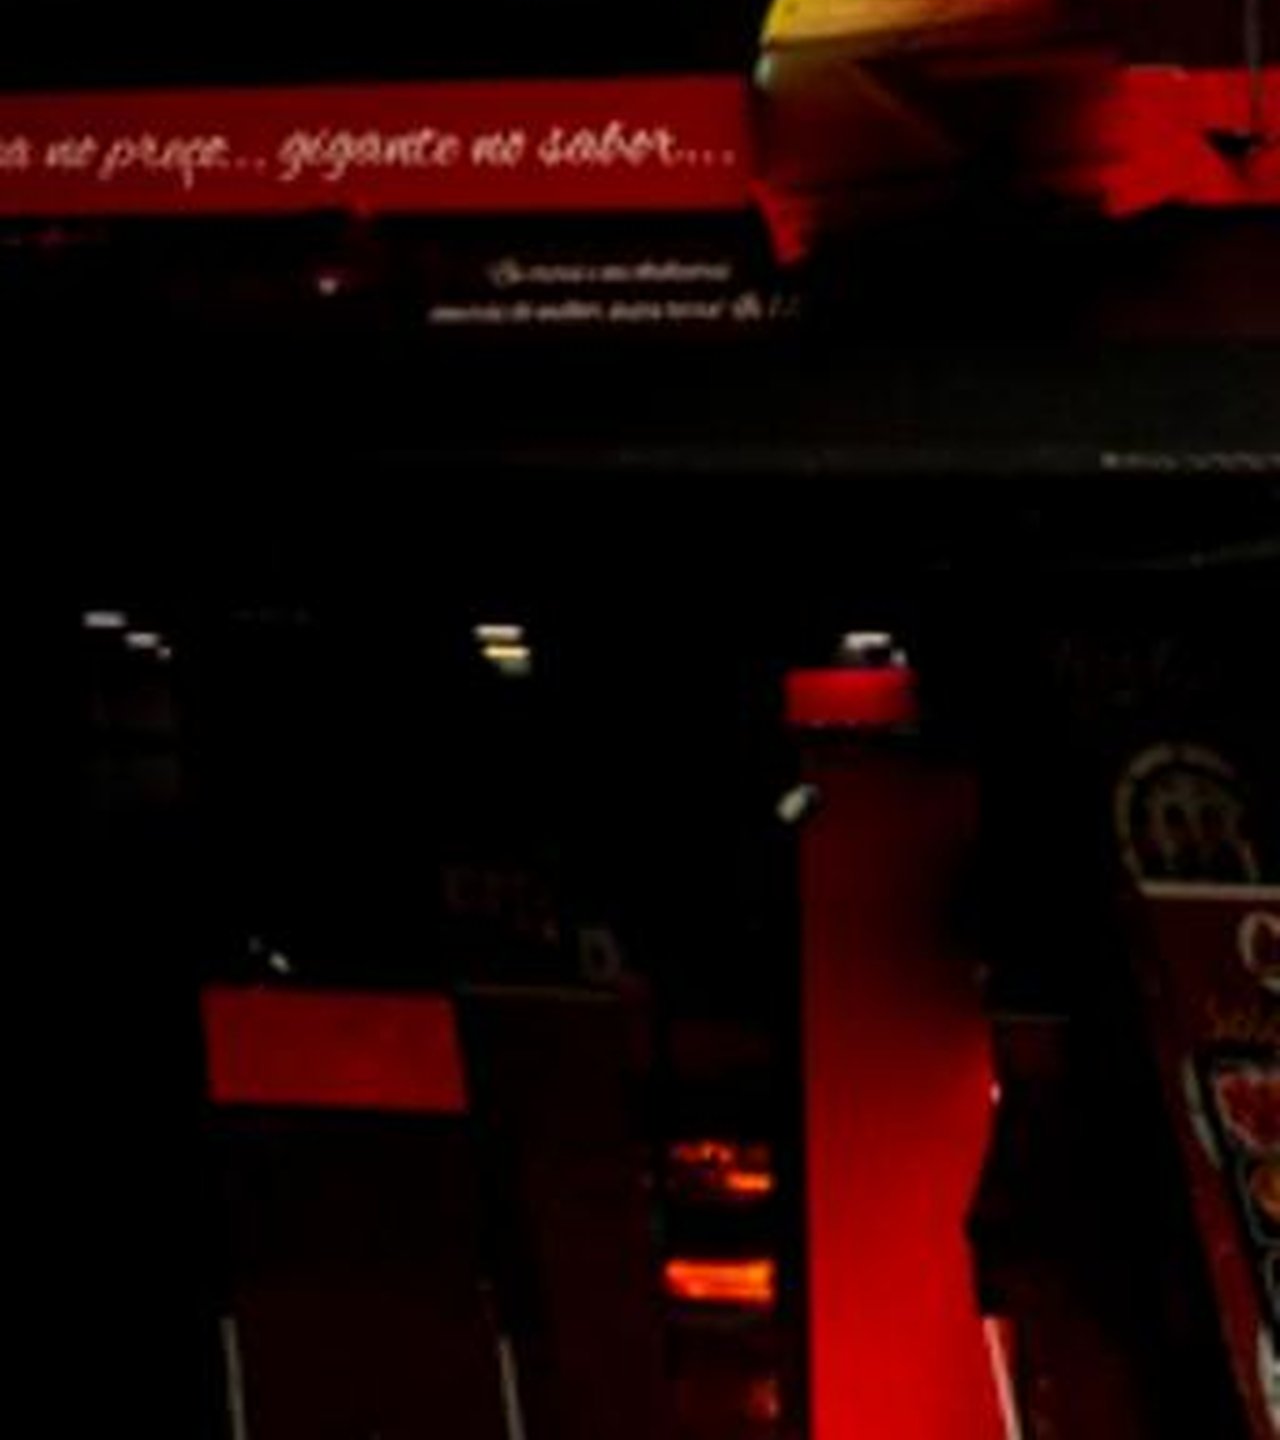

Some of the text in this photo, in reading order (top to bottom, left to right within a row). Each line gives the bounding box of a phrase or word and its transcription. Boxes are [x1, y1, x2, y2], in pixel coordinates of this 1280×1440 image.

[44, 133, 100, 169] no
[275, 126, 463, 183] gigante
[469, 128, 529, 167] no
